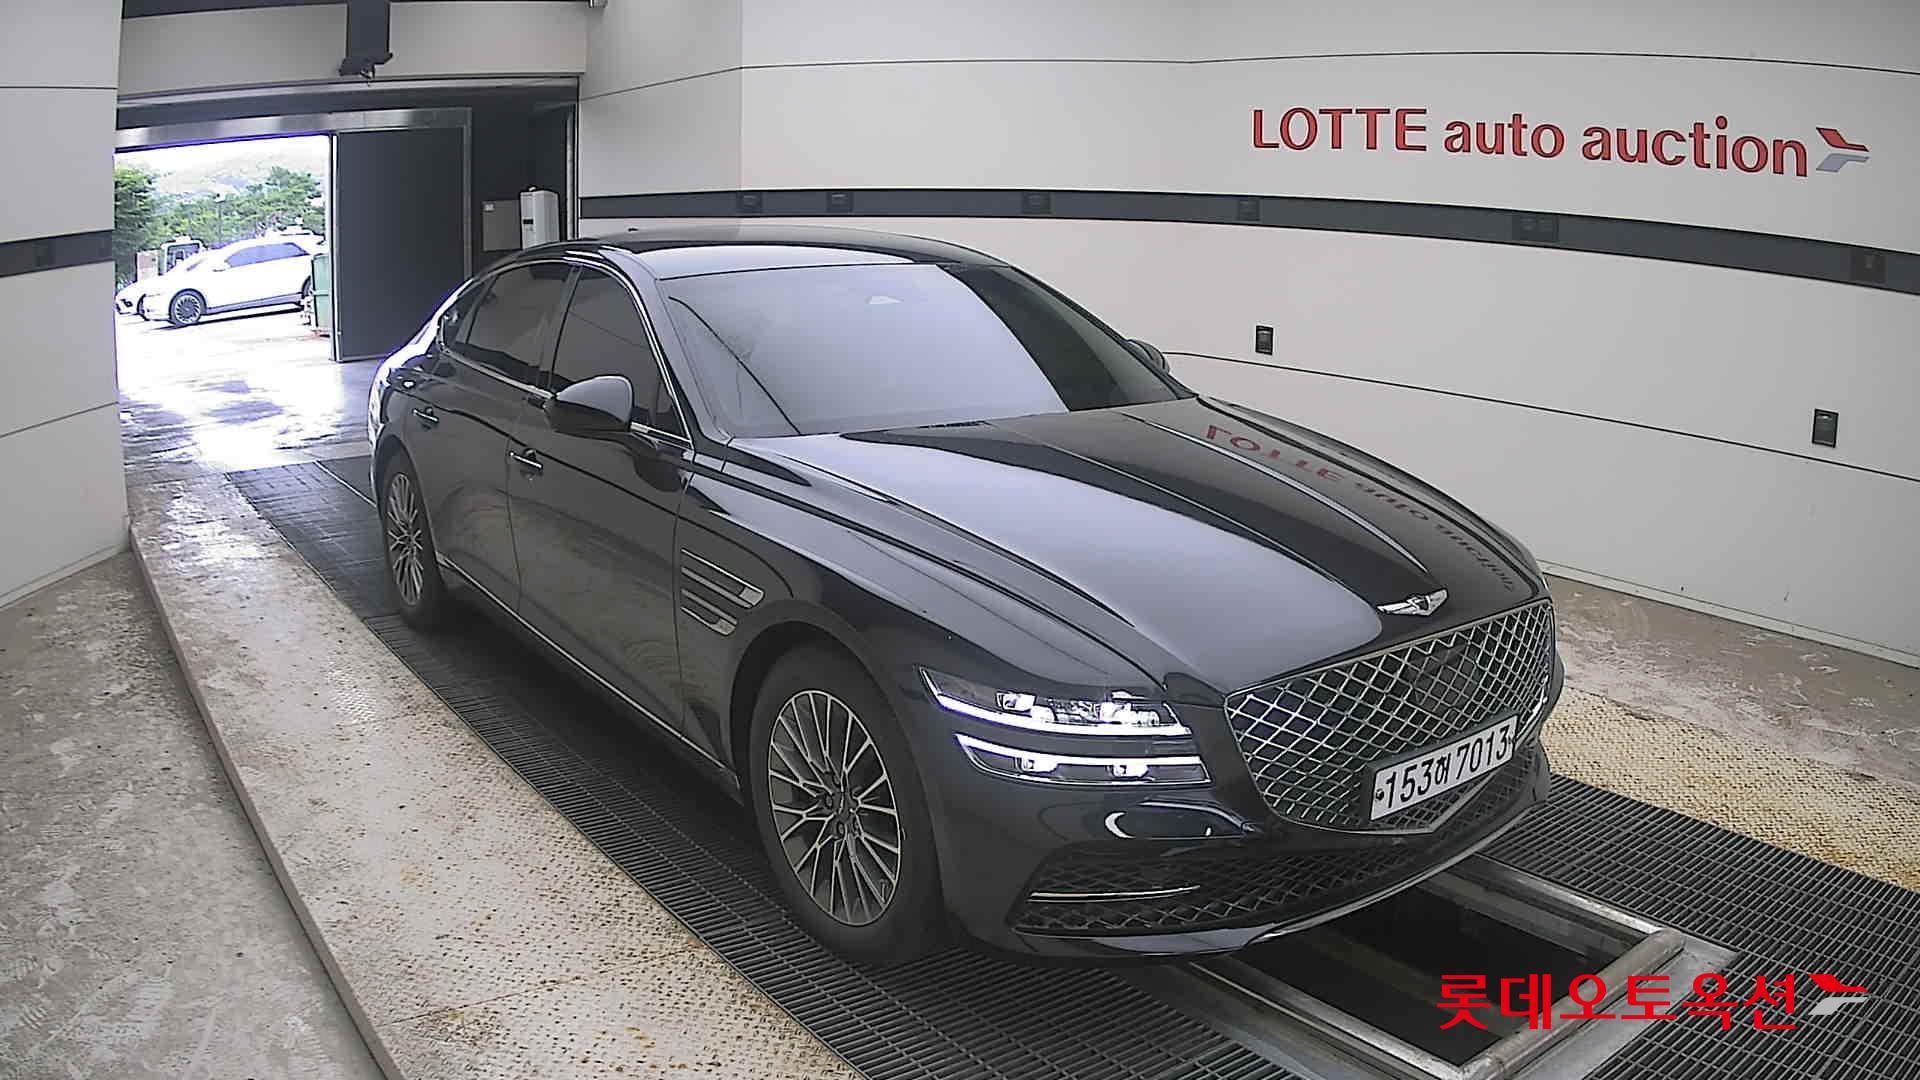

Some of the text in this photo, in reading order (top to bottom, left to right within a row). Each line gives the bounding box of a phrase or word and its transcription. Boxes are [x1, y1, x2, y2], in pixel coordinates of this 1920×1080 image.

[1253, 107, 1808, 177] LOTTE auto auction
[1456, 725, 1511, 780] 7013
